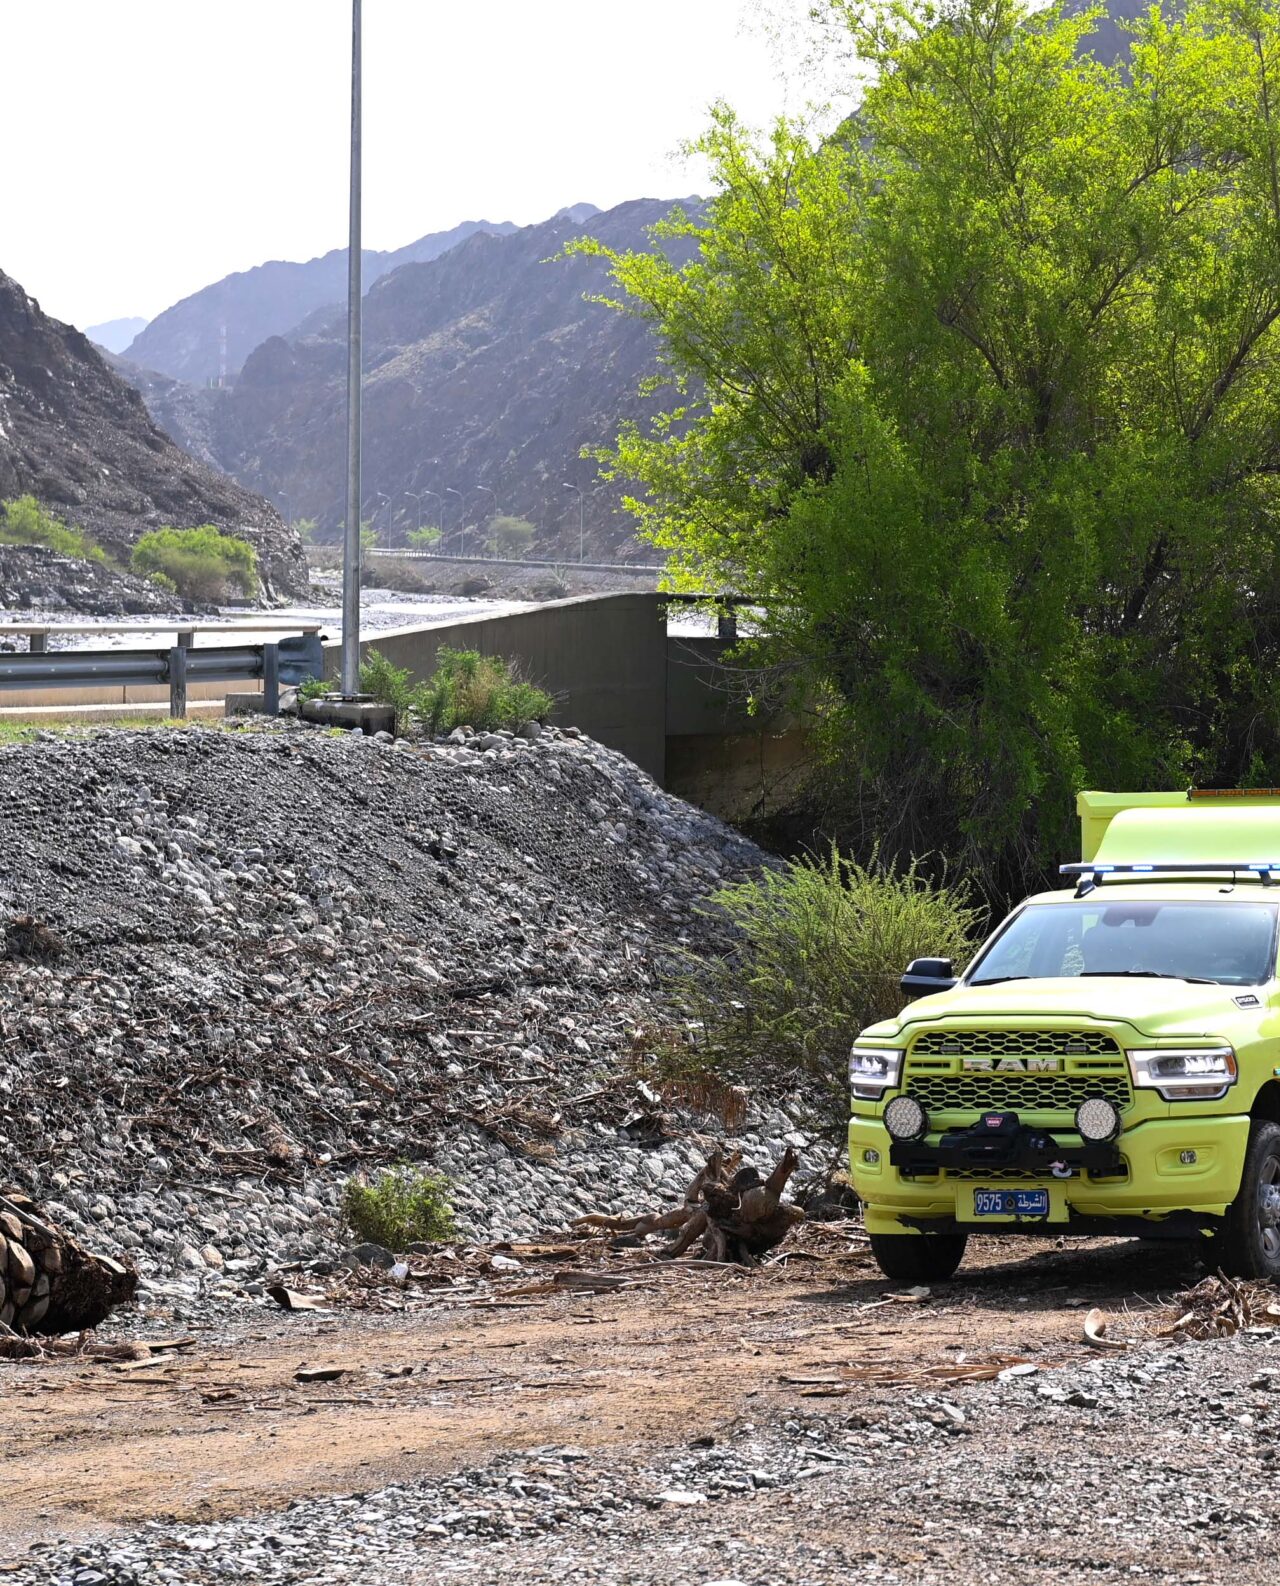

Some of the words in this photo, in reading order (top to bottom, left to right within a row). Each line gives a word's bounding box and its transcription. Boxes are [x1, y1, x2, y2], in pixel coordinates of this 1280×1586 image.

[963, 1058, 1058, 1072] RAM
[977, 1193, 1002, 1211] 9575
[1018, 1193, 1045, 1210] الشرطة
